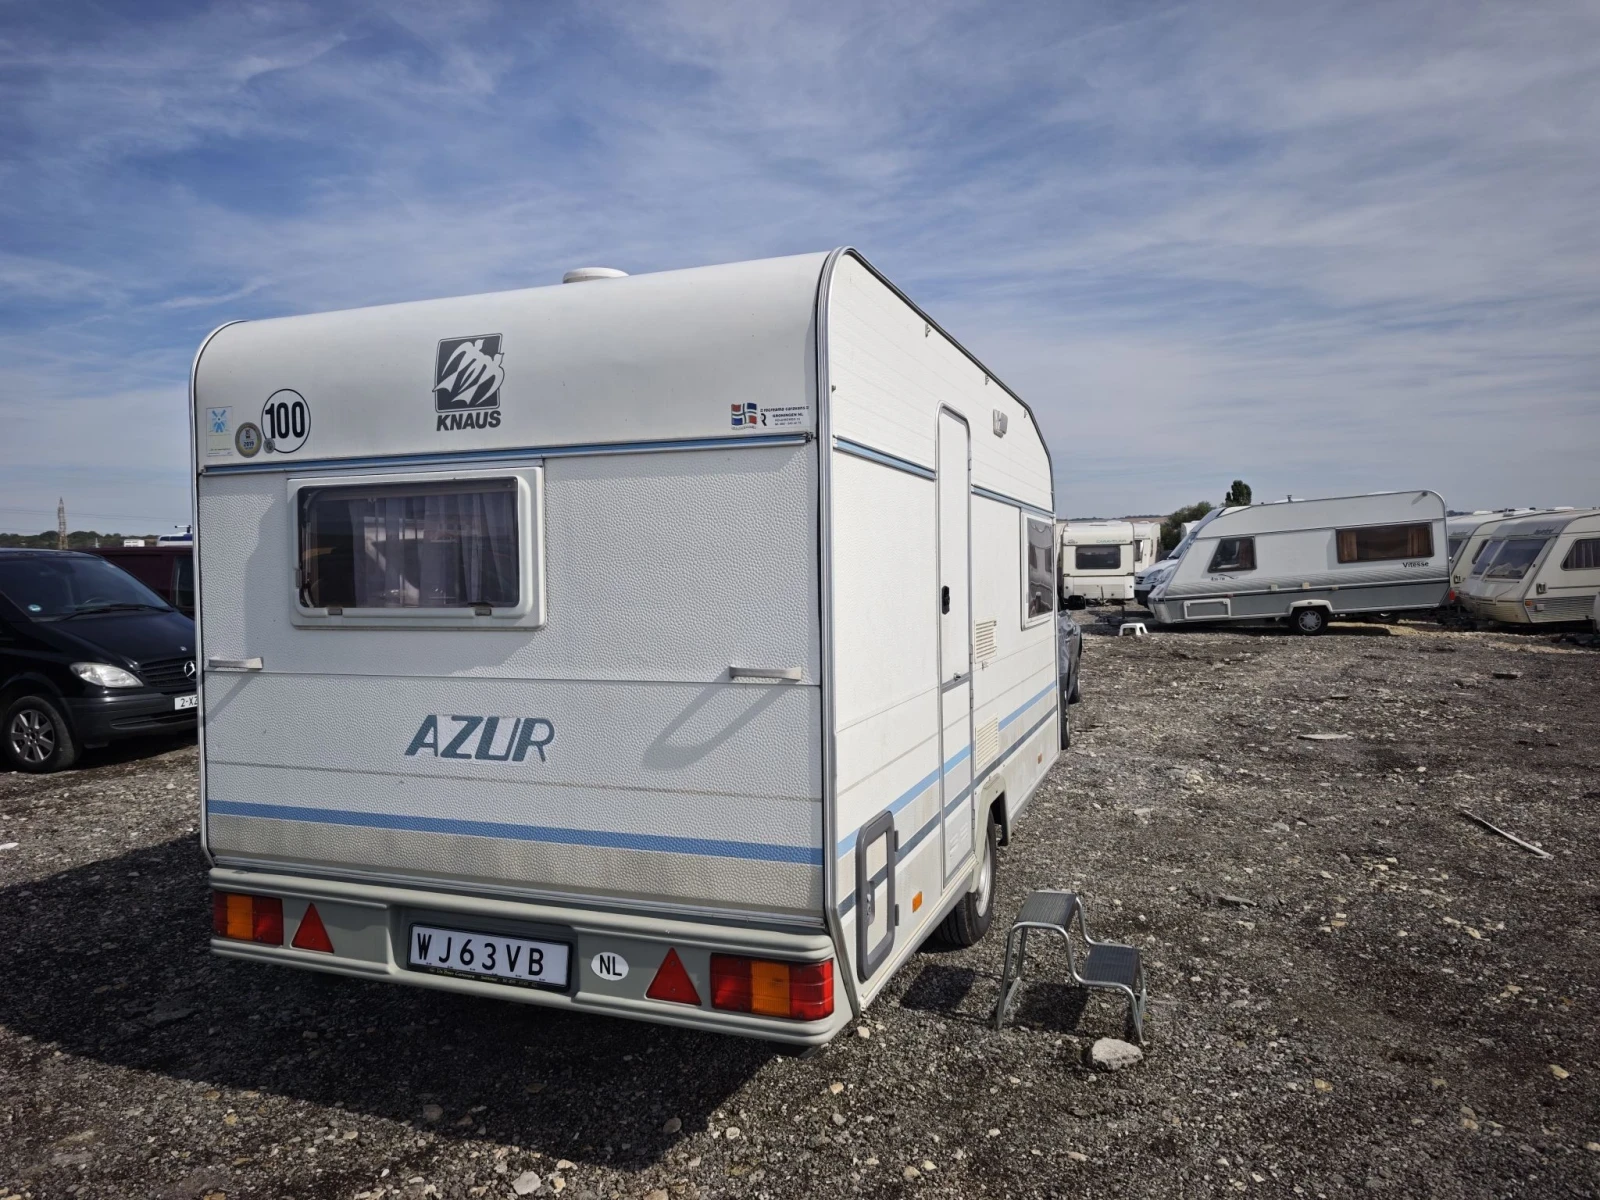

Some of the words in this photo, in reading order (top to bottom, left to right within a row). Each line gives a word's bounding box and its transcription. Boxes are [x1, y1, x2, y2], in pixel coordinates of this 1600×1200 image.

[264, 401, 306, 439] 100
[436, 410, 502, 432] KNAUS
[404, 714, 556, 763] AZUR
[417, 932, 544, 977] WJ63VB
[599, 954, 623, 977] NL
